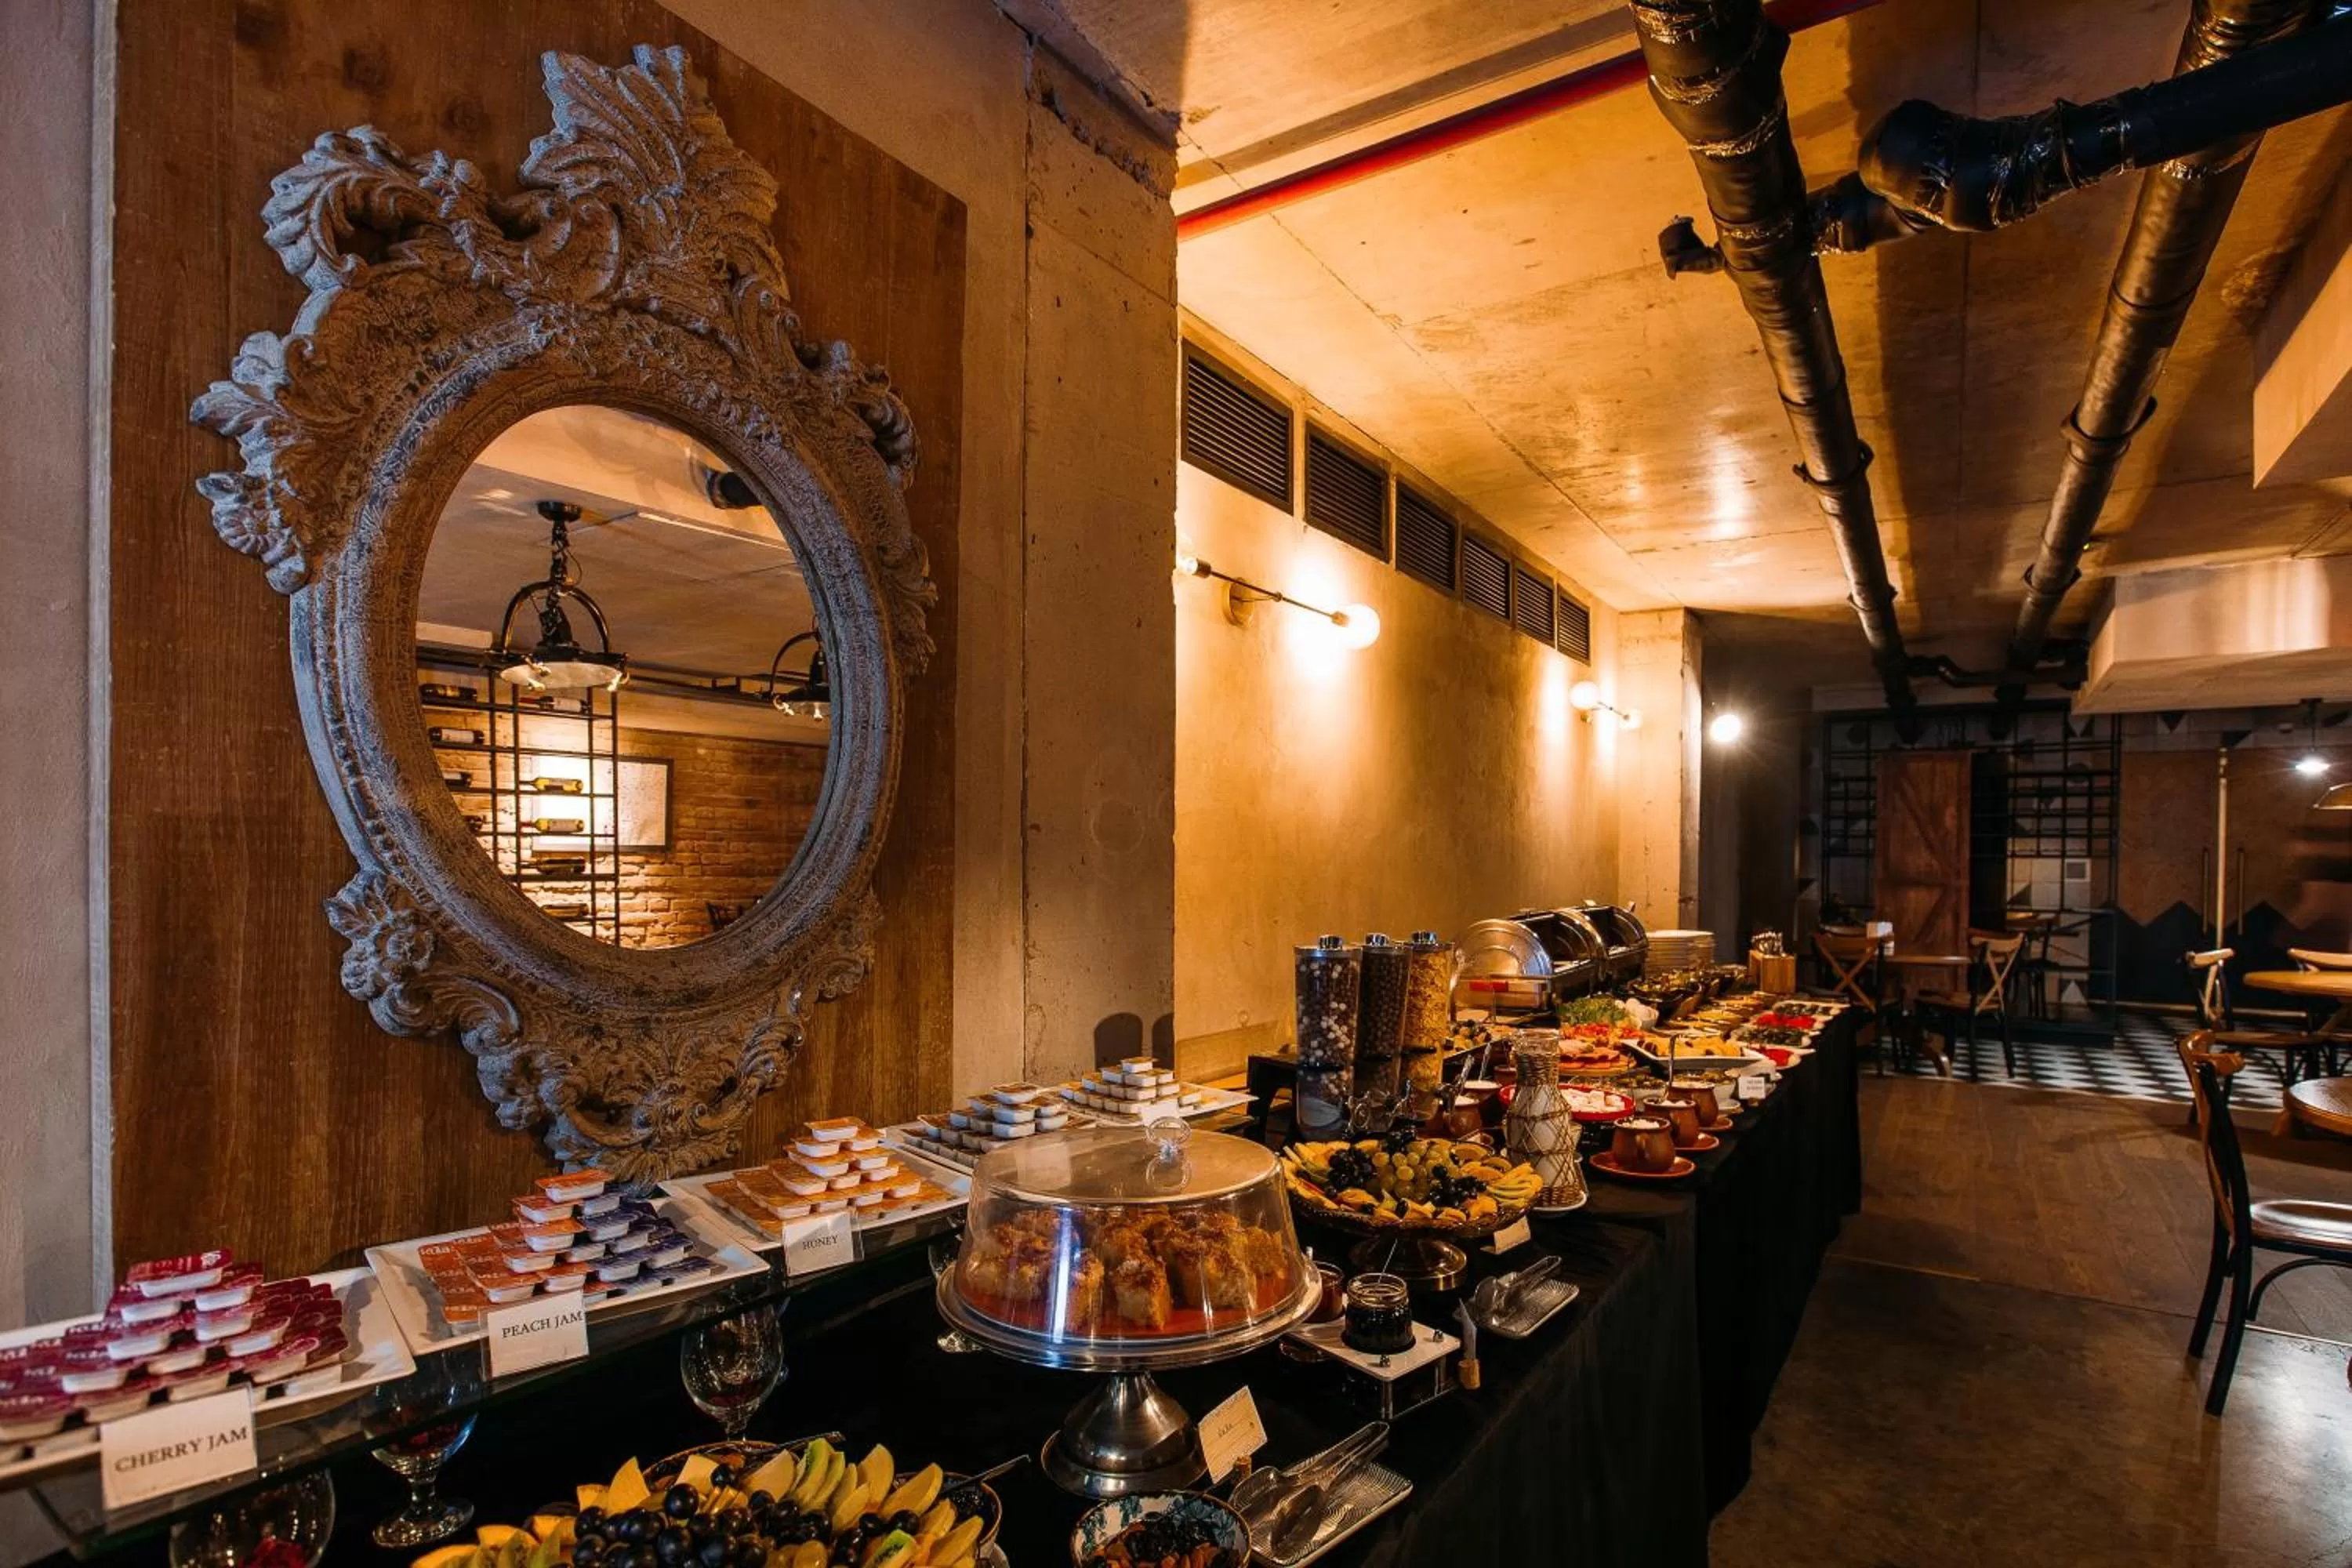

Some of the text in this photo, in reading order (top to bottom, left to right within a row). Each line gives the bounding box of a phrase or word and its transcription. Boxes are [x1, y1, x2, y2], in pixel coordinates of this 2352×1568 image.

[803, 1235, 837, 1250] HONEY
[502, 1310, 584, 1338] PEACH JAM
[114, 1426, 249, 1472] CHERRY JAM
